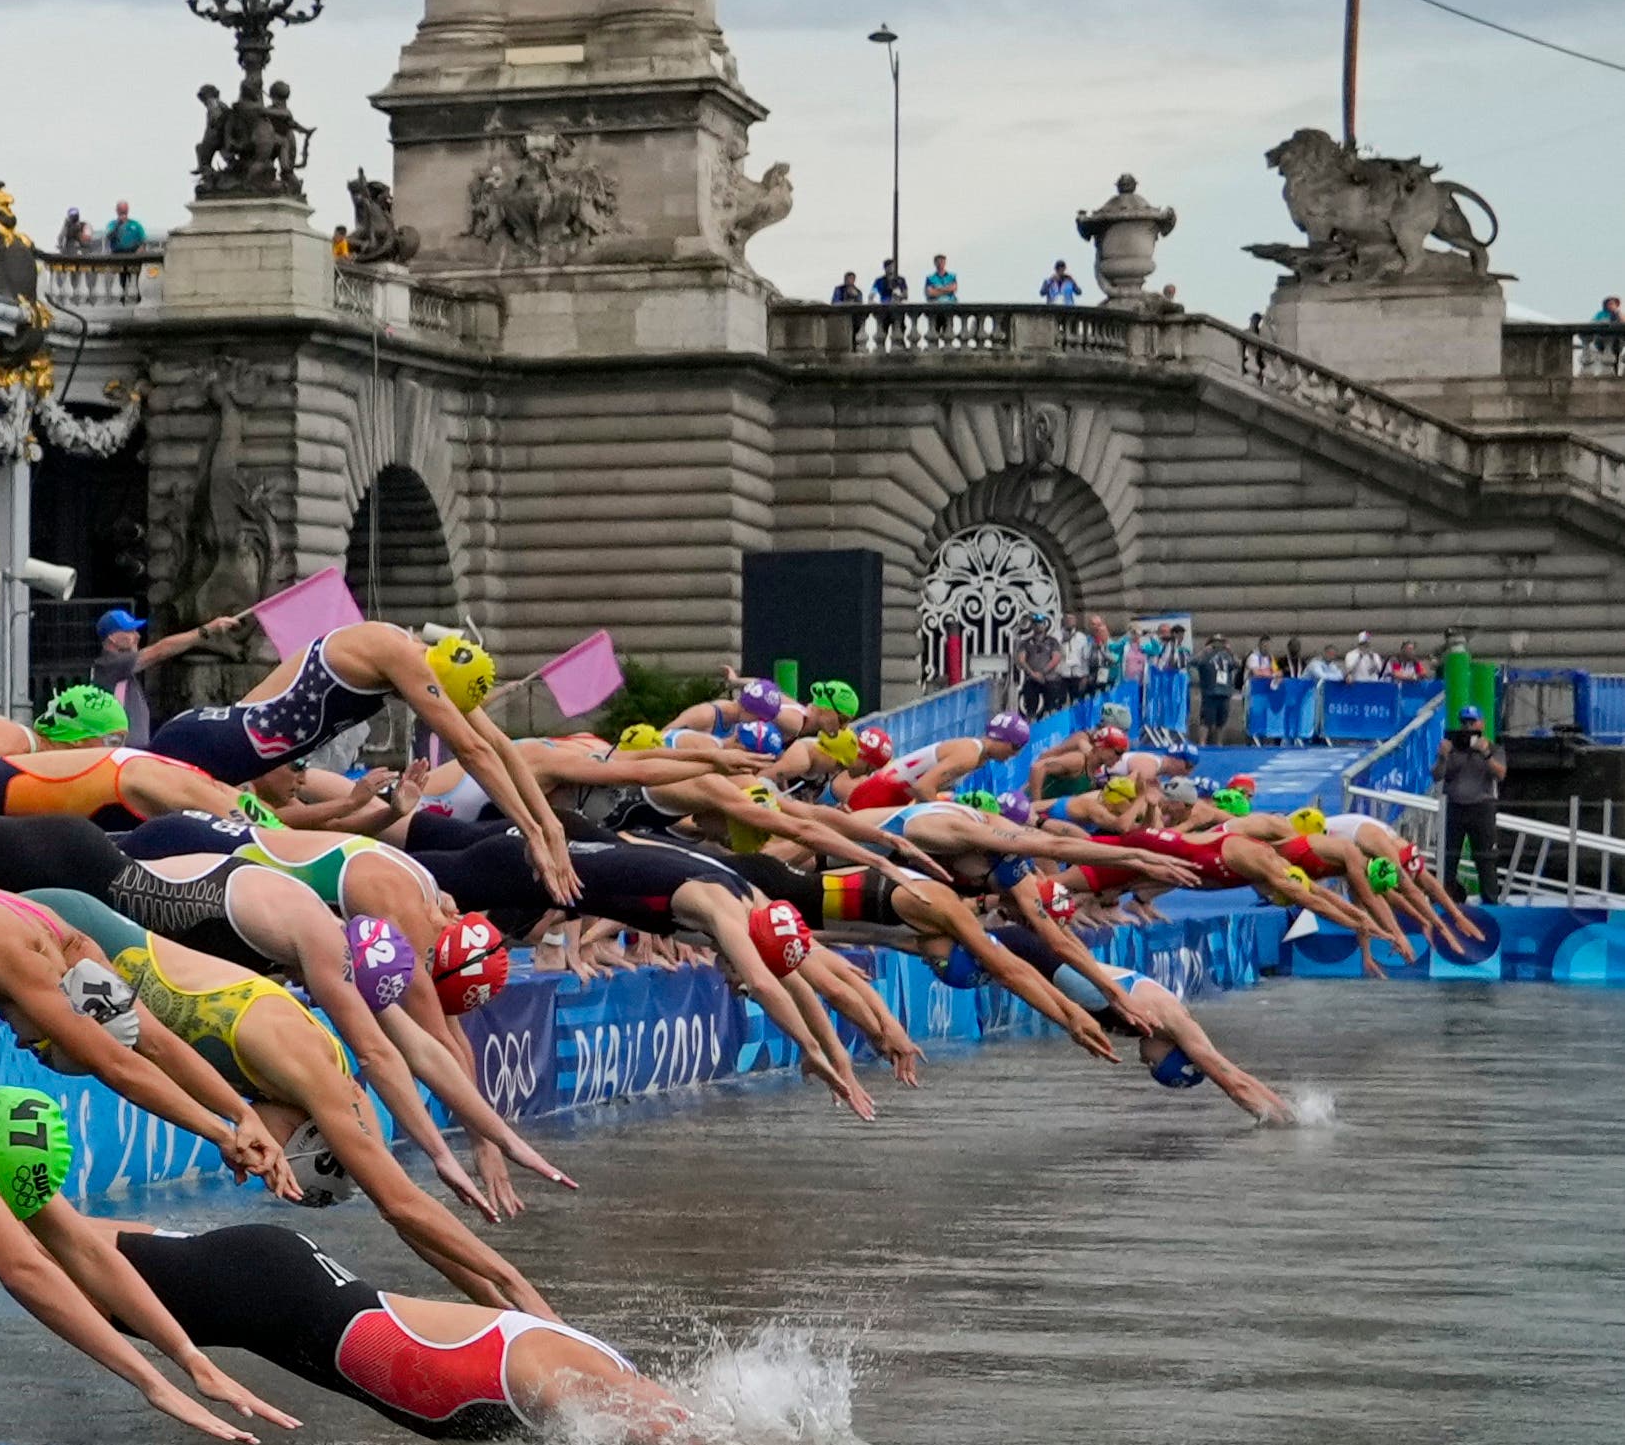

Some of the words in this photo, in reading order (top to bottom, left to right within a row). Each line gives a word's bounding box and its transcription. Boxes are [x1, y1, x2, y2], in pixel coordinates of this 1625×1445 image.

[358, 919, 396, 969] 52
[769, 904, 799, 937] 27
[9, 1098, 50, 1152] 47
